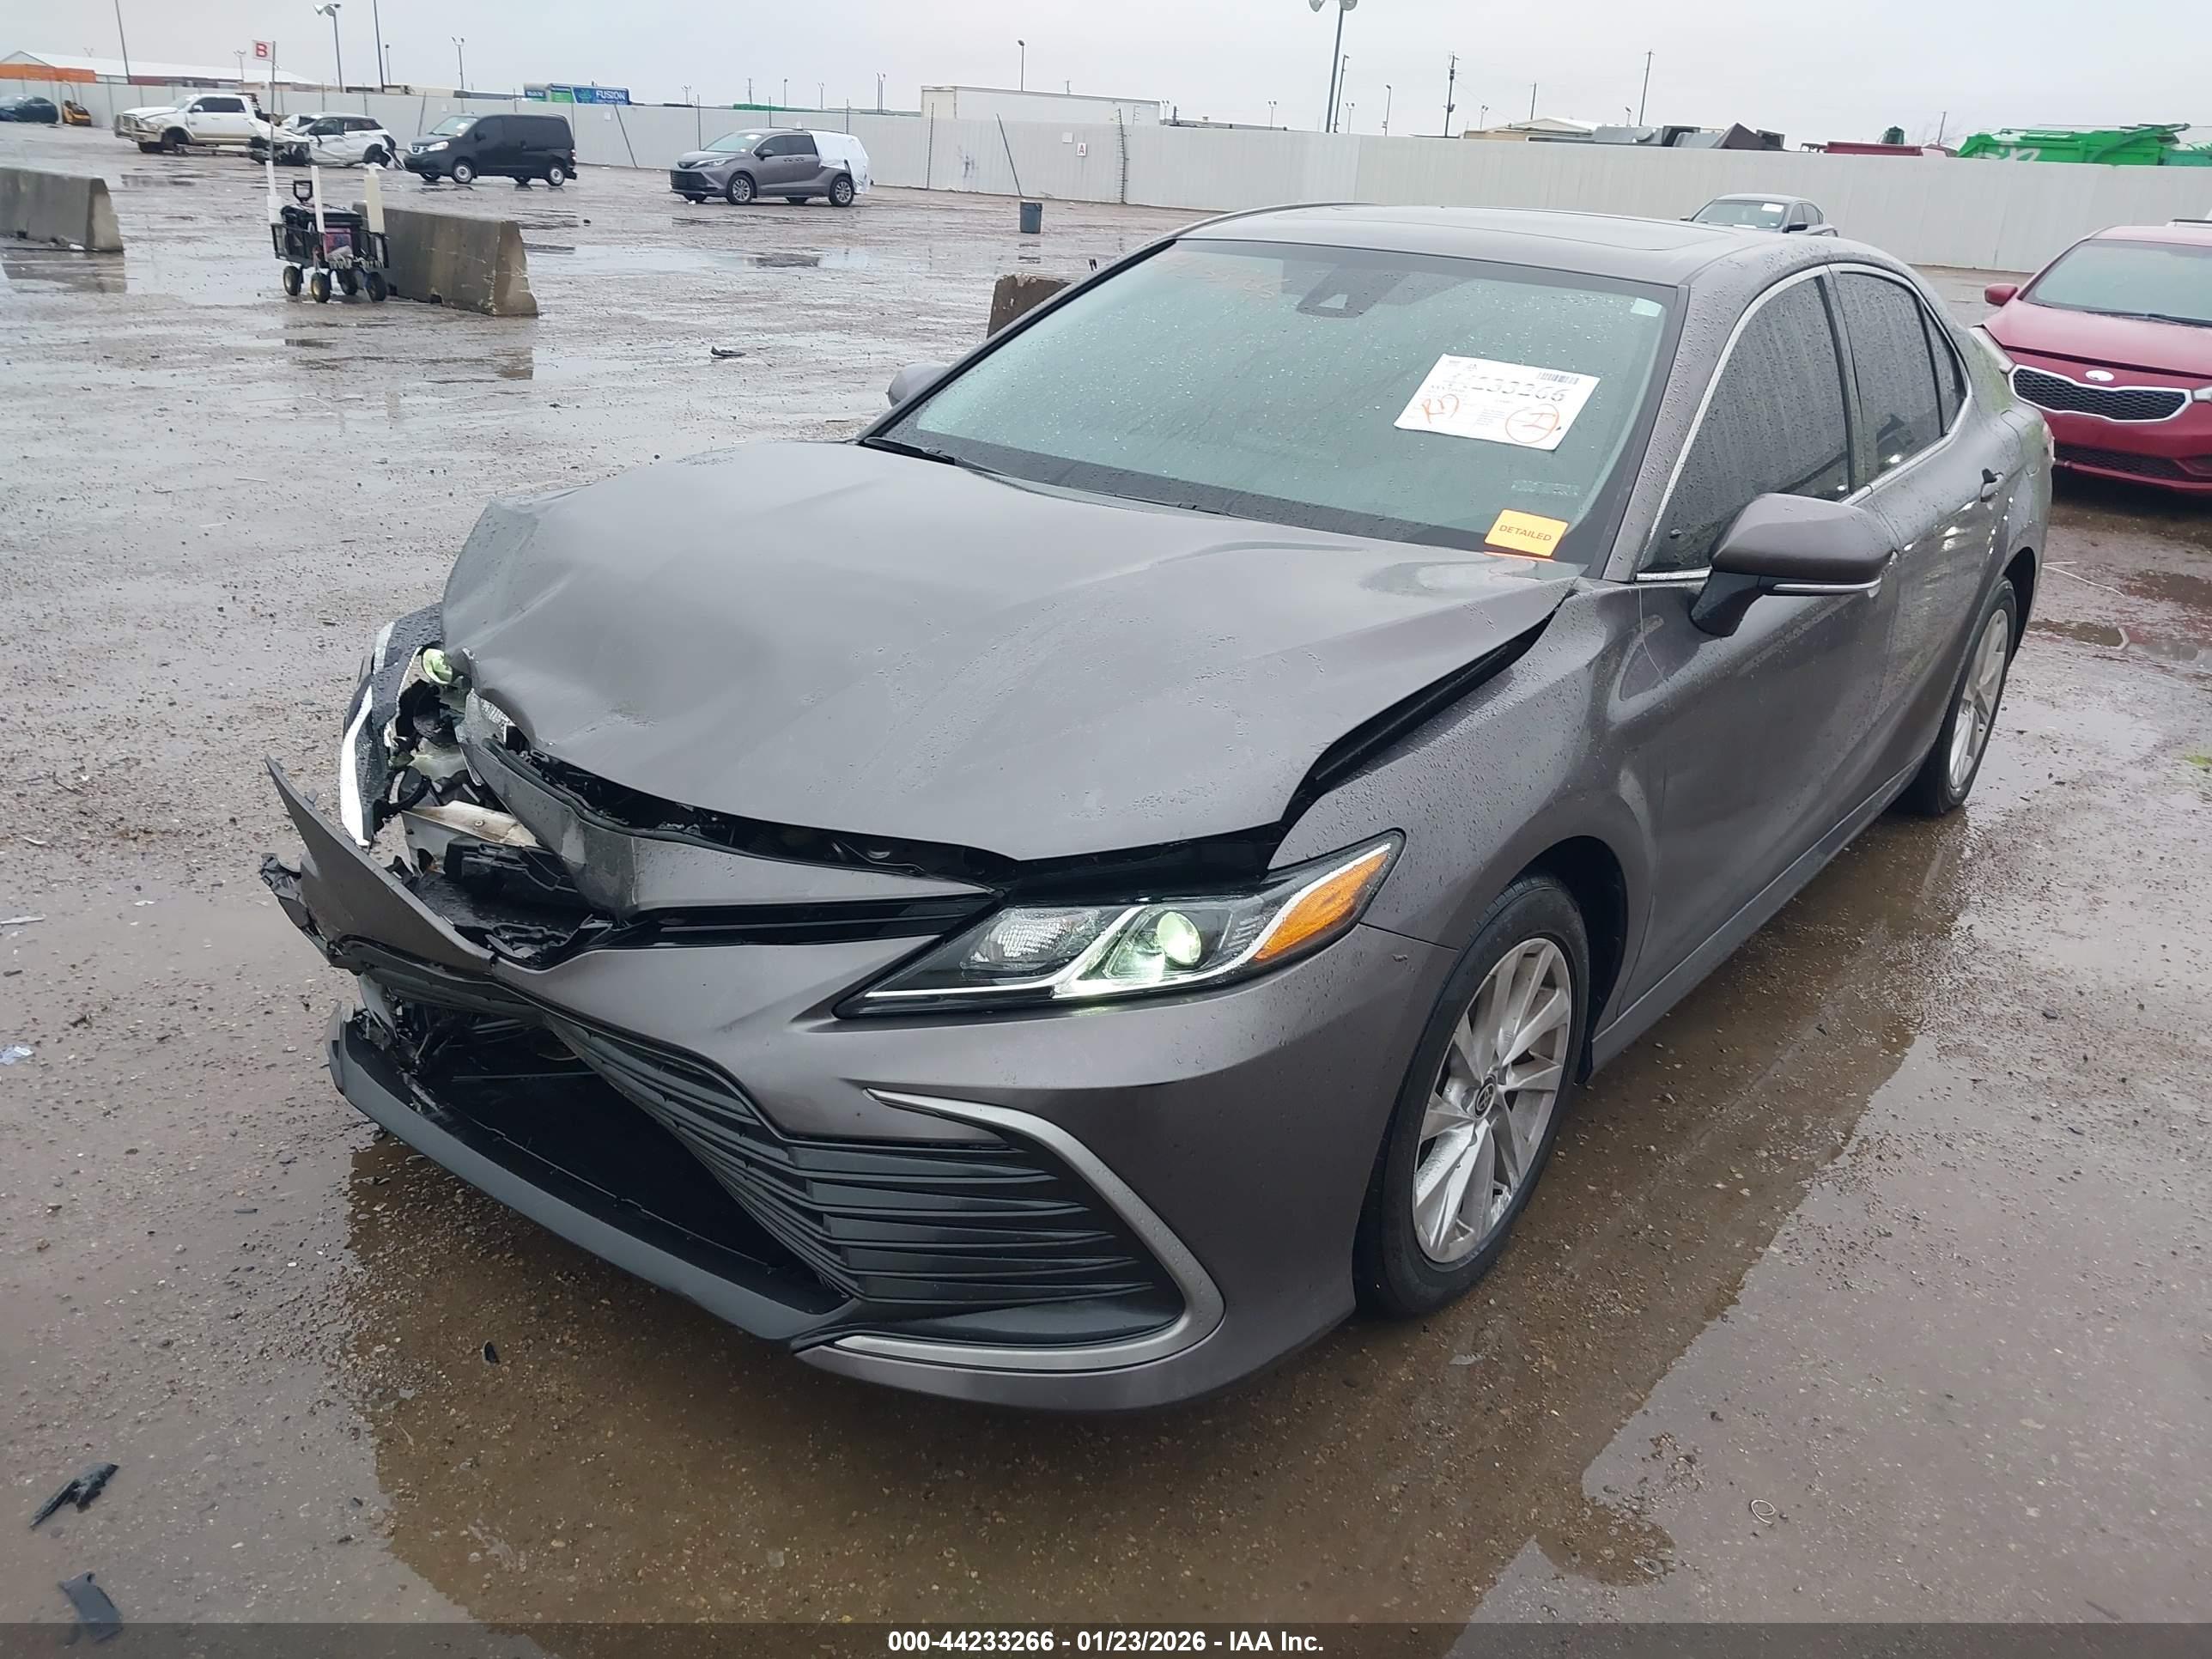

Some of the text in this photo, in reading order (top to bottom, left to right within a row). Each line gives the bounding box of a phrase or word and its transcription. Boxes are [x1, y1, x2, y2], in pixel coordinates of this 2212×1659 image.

[256, 43, 267, 58] B
[596, 89, 626, 100] FUSION
[1079, 144, 1085, 155] A
[1446, 374, 1570, 402] 233266
[1498, 525, 1553, 542] DETAILED
